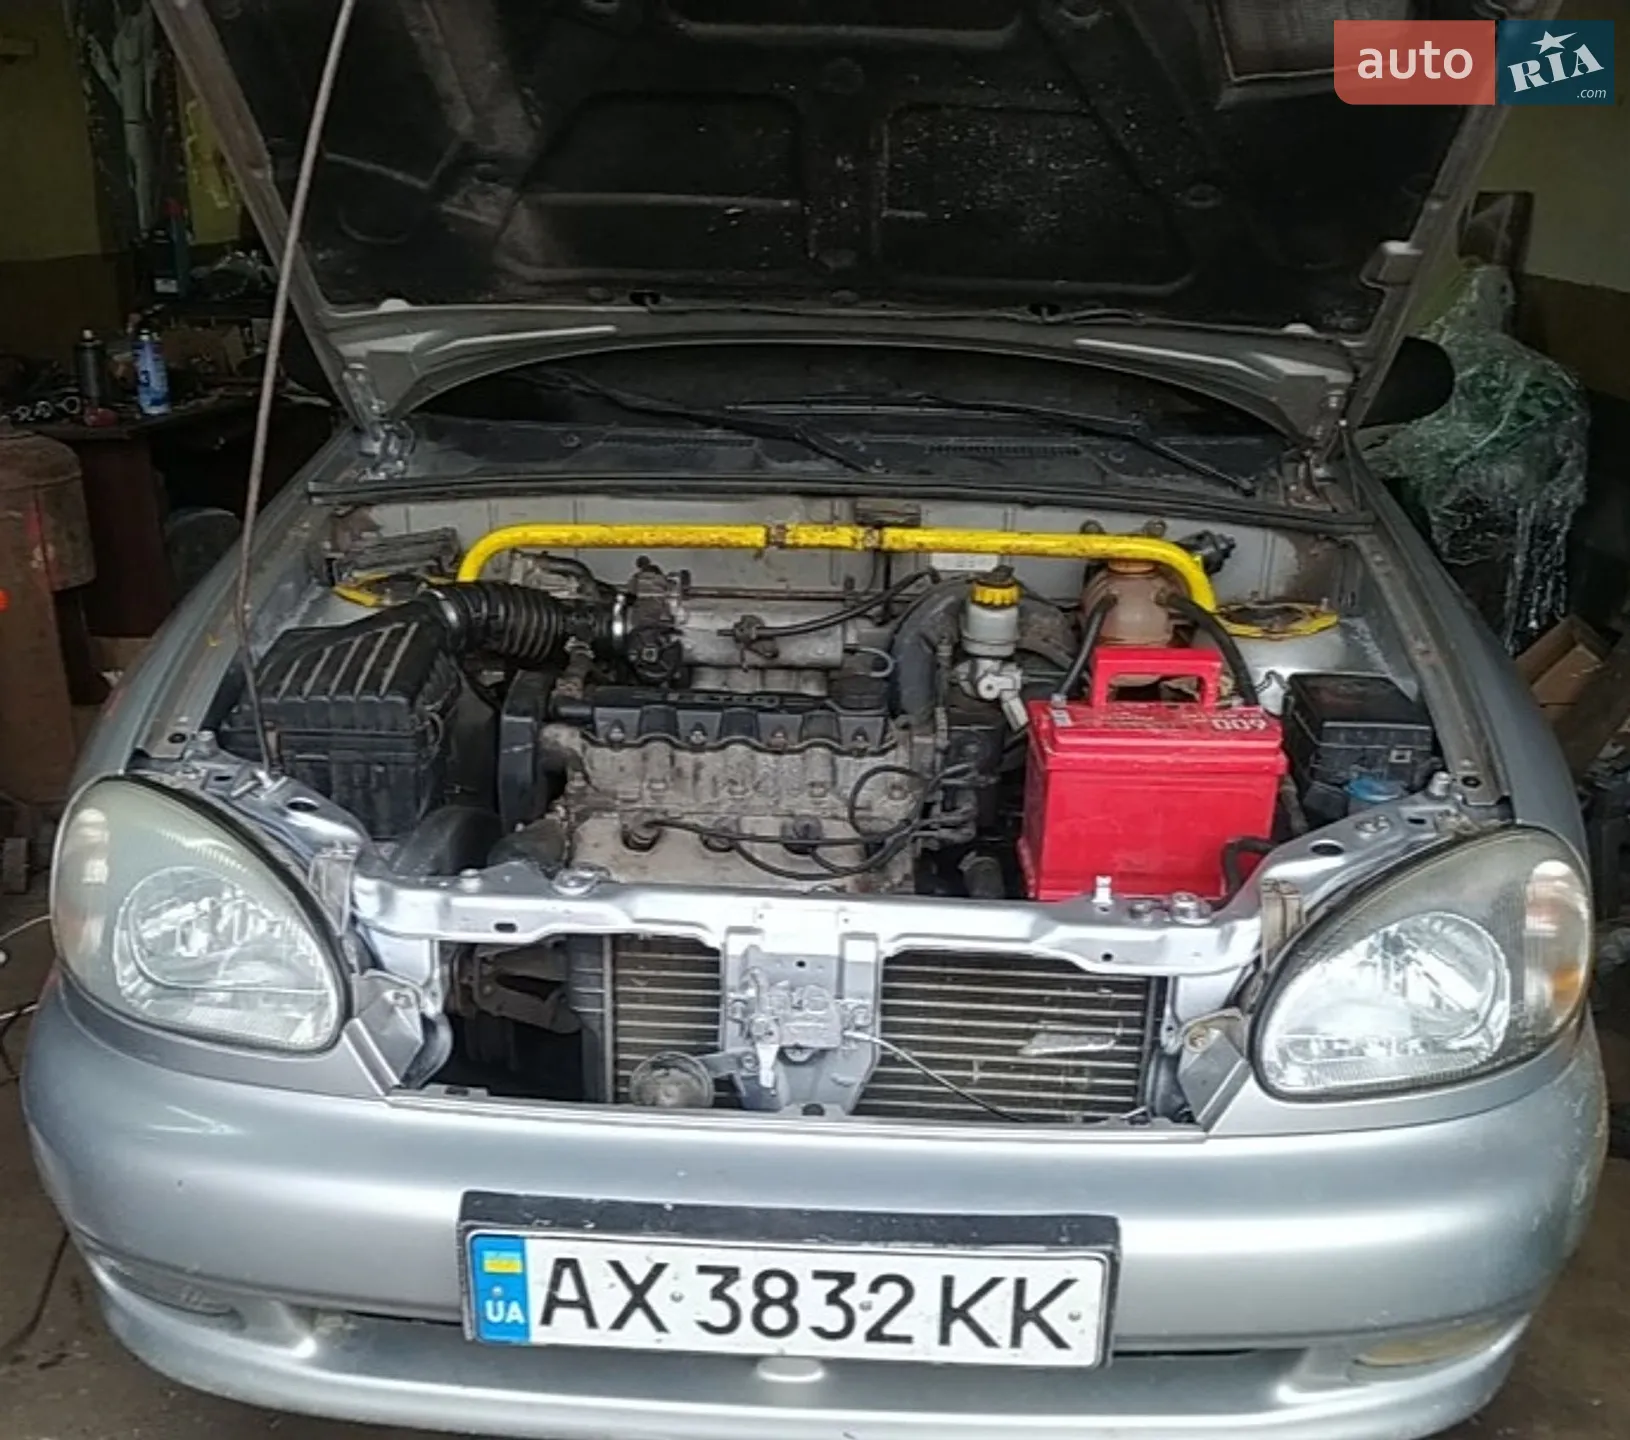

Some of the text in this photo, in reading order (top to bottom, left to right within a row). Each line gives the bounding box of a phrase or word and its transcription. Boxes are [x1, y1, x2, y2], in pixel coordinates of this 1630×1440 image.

[484, 1299, 526, 1325] UA
[538, 1256, 1079, 1350] AX 3832 KK
